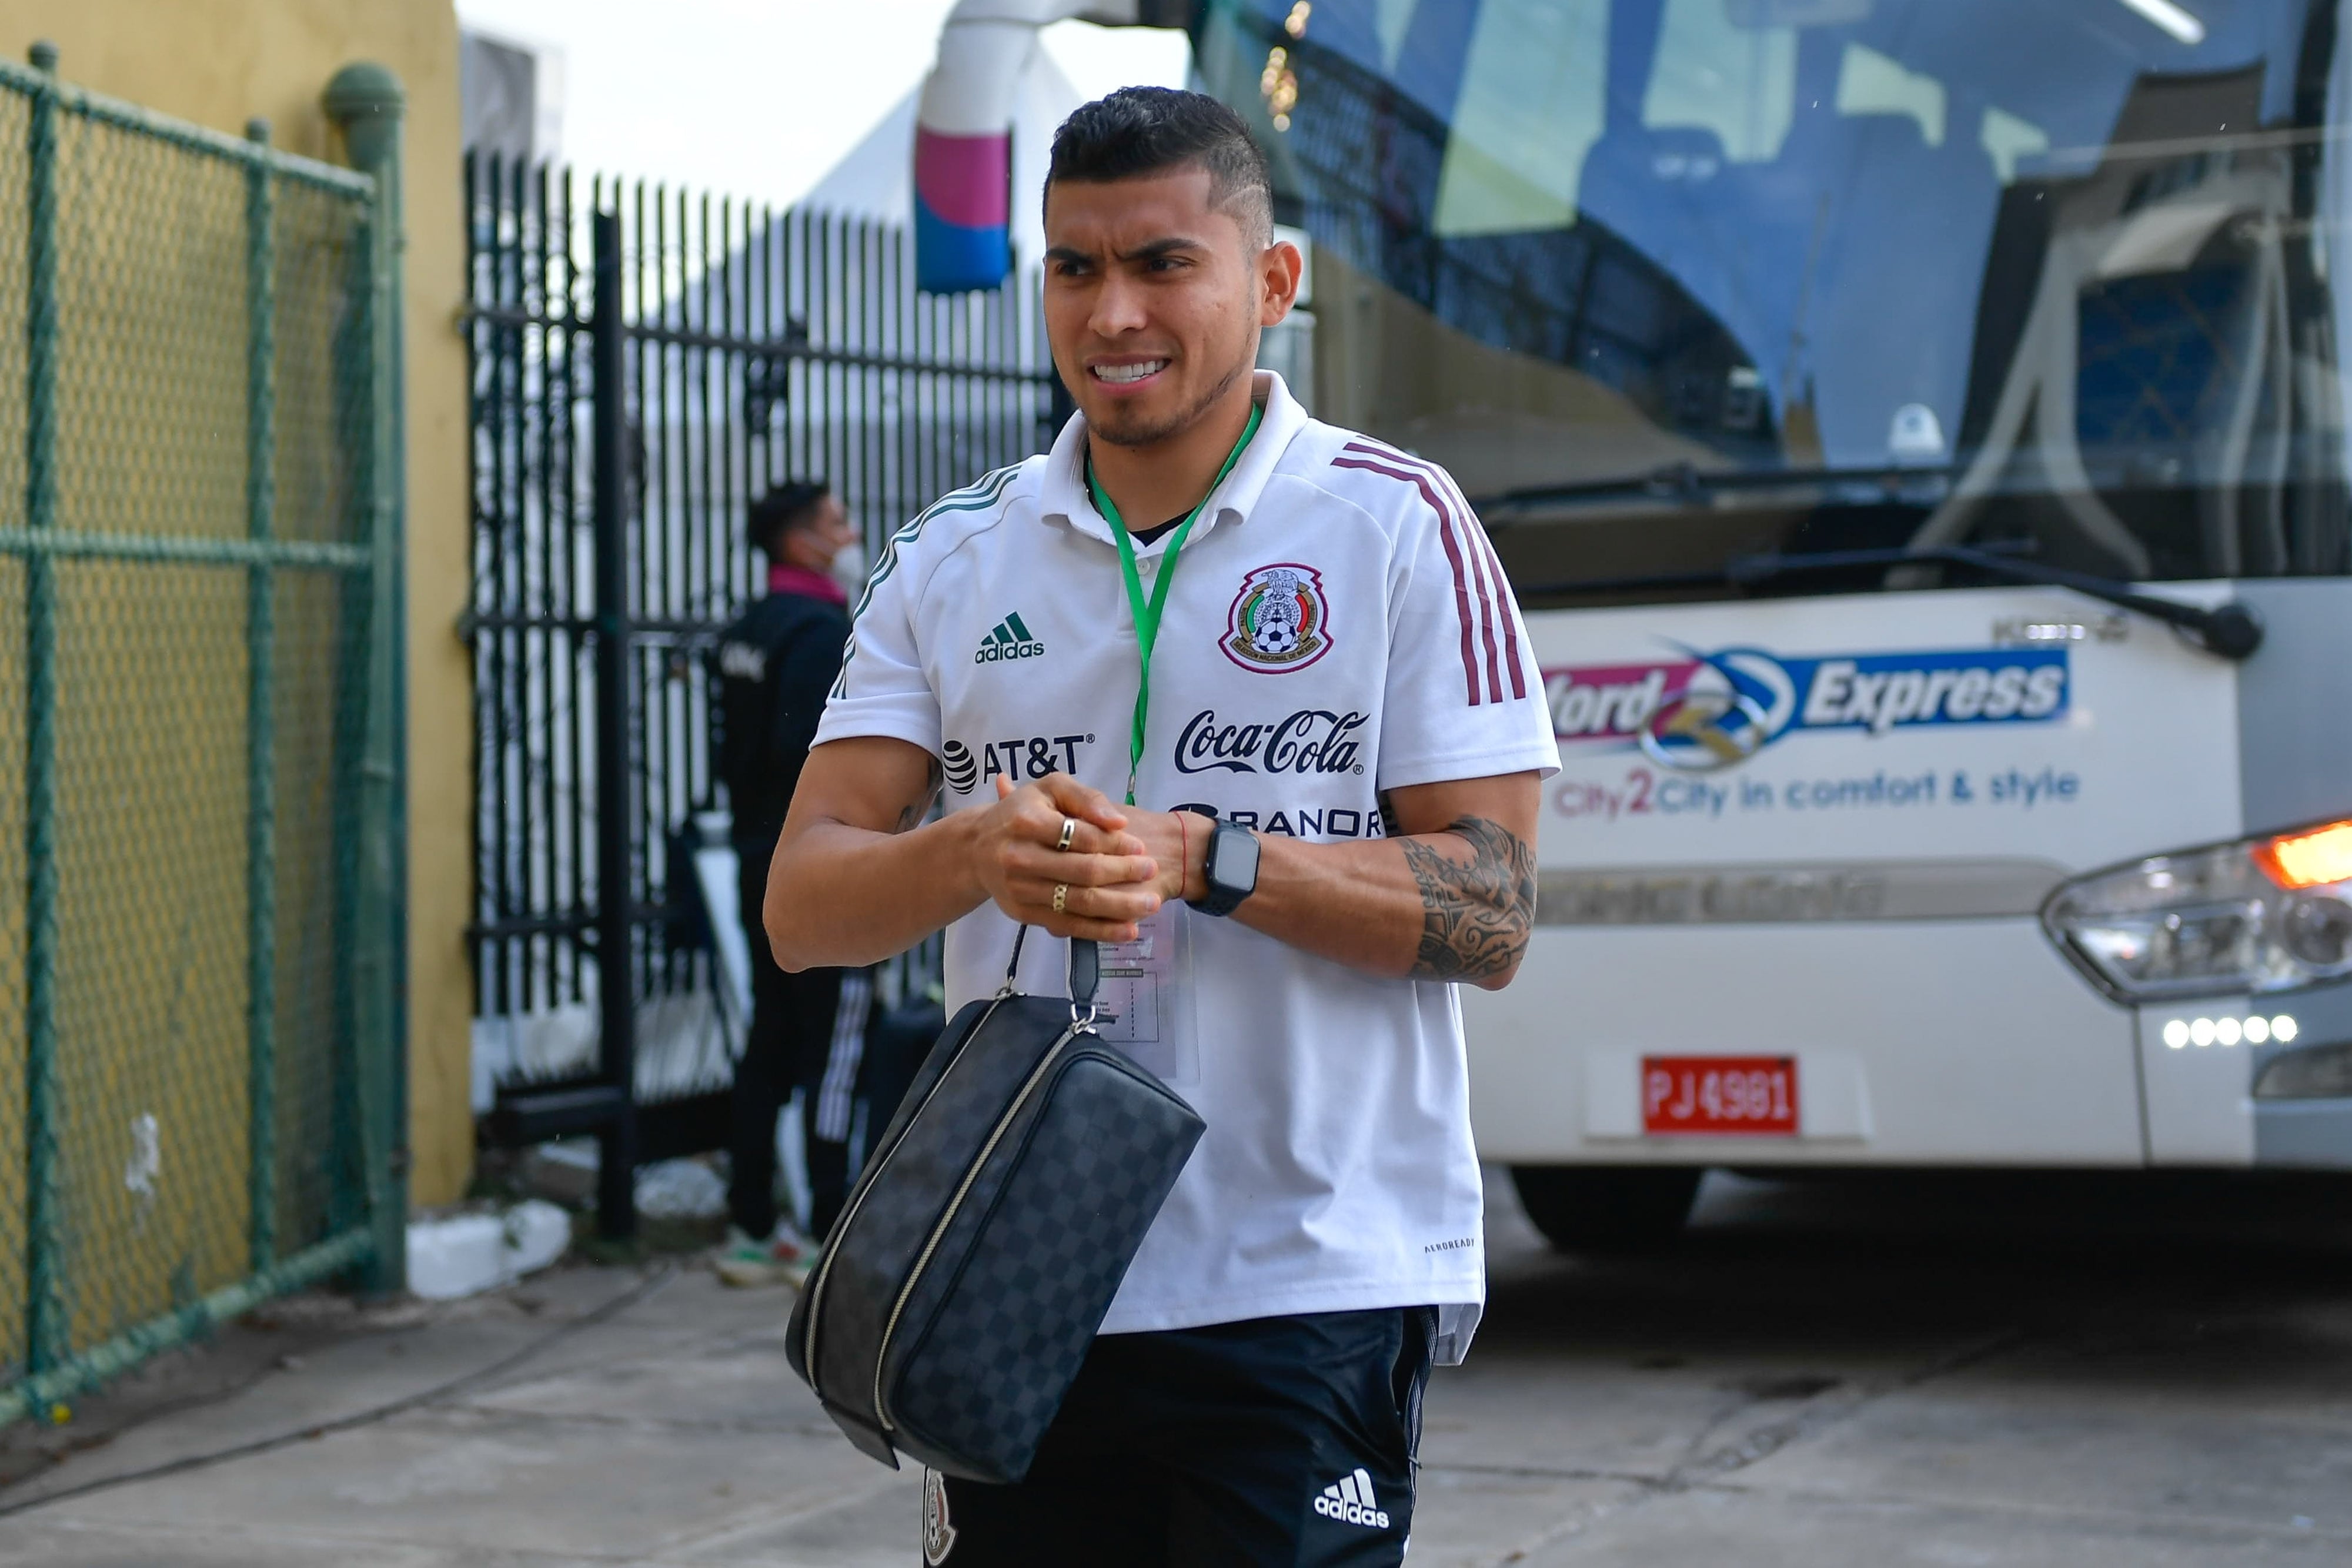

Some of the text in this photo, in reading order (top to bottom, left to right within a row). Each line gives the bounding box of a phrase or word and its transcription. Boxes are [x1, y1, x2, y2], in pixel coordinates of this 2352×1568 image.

[974, 642, 1044, 664] adidas
[1802, 660, 2064, 734] Express
[1739, 777, 1774, 812] in
[1786, 768, 1936, 809] comfort
[1951, 769, 1973, 805] &
[1990, 766, 2080, 810] style
[1425, 1238, 1475, 1254] AEROREADY
[1314, 1495, 1390, 1529] adidas
